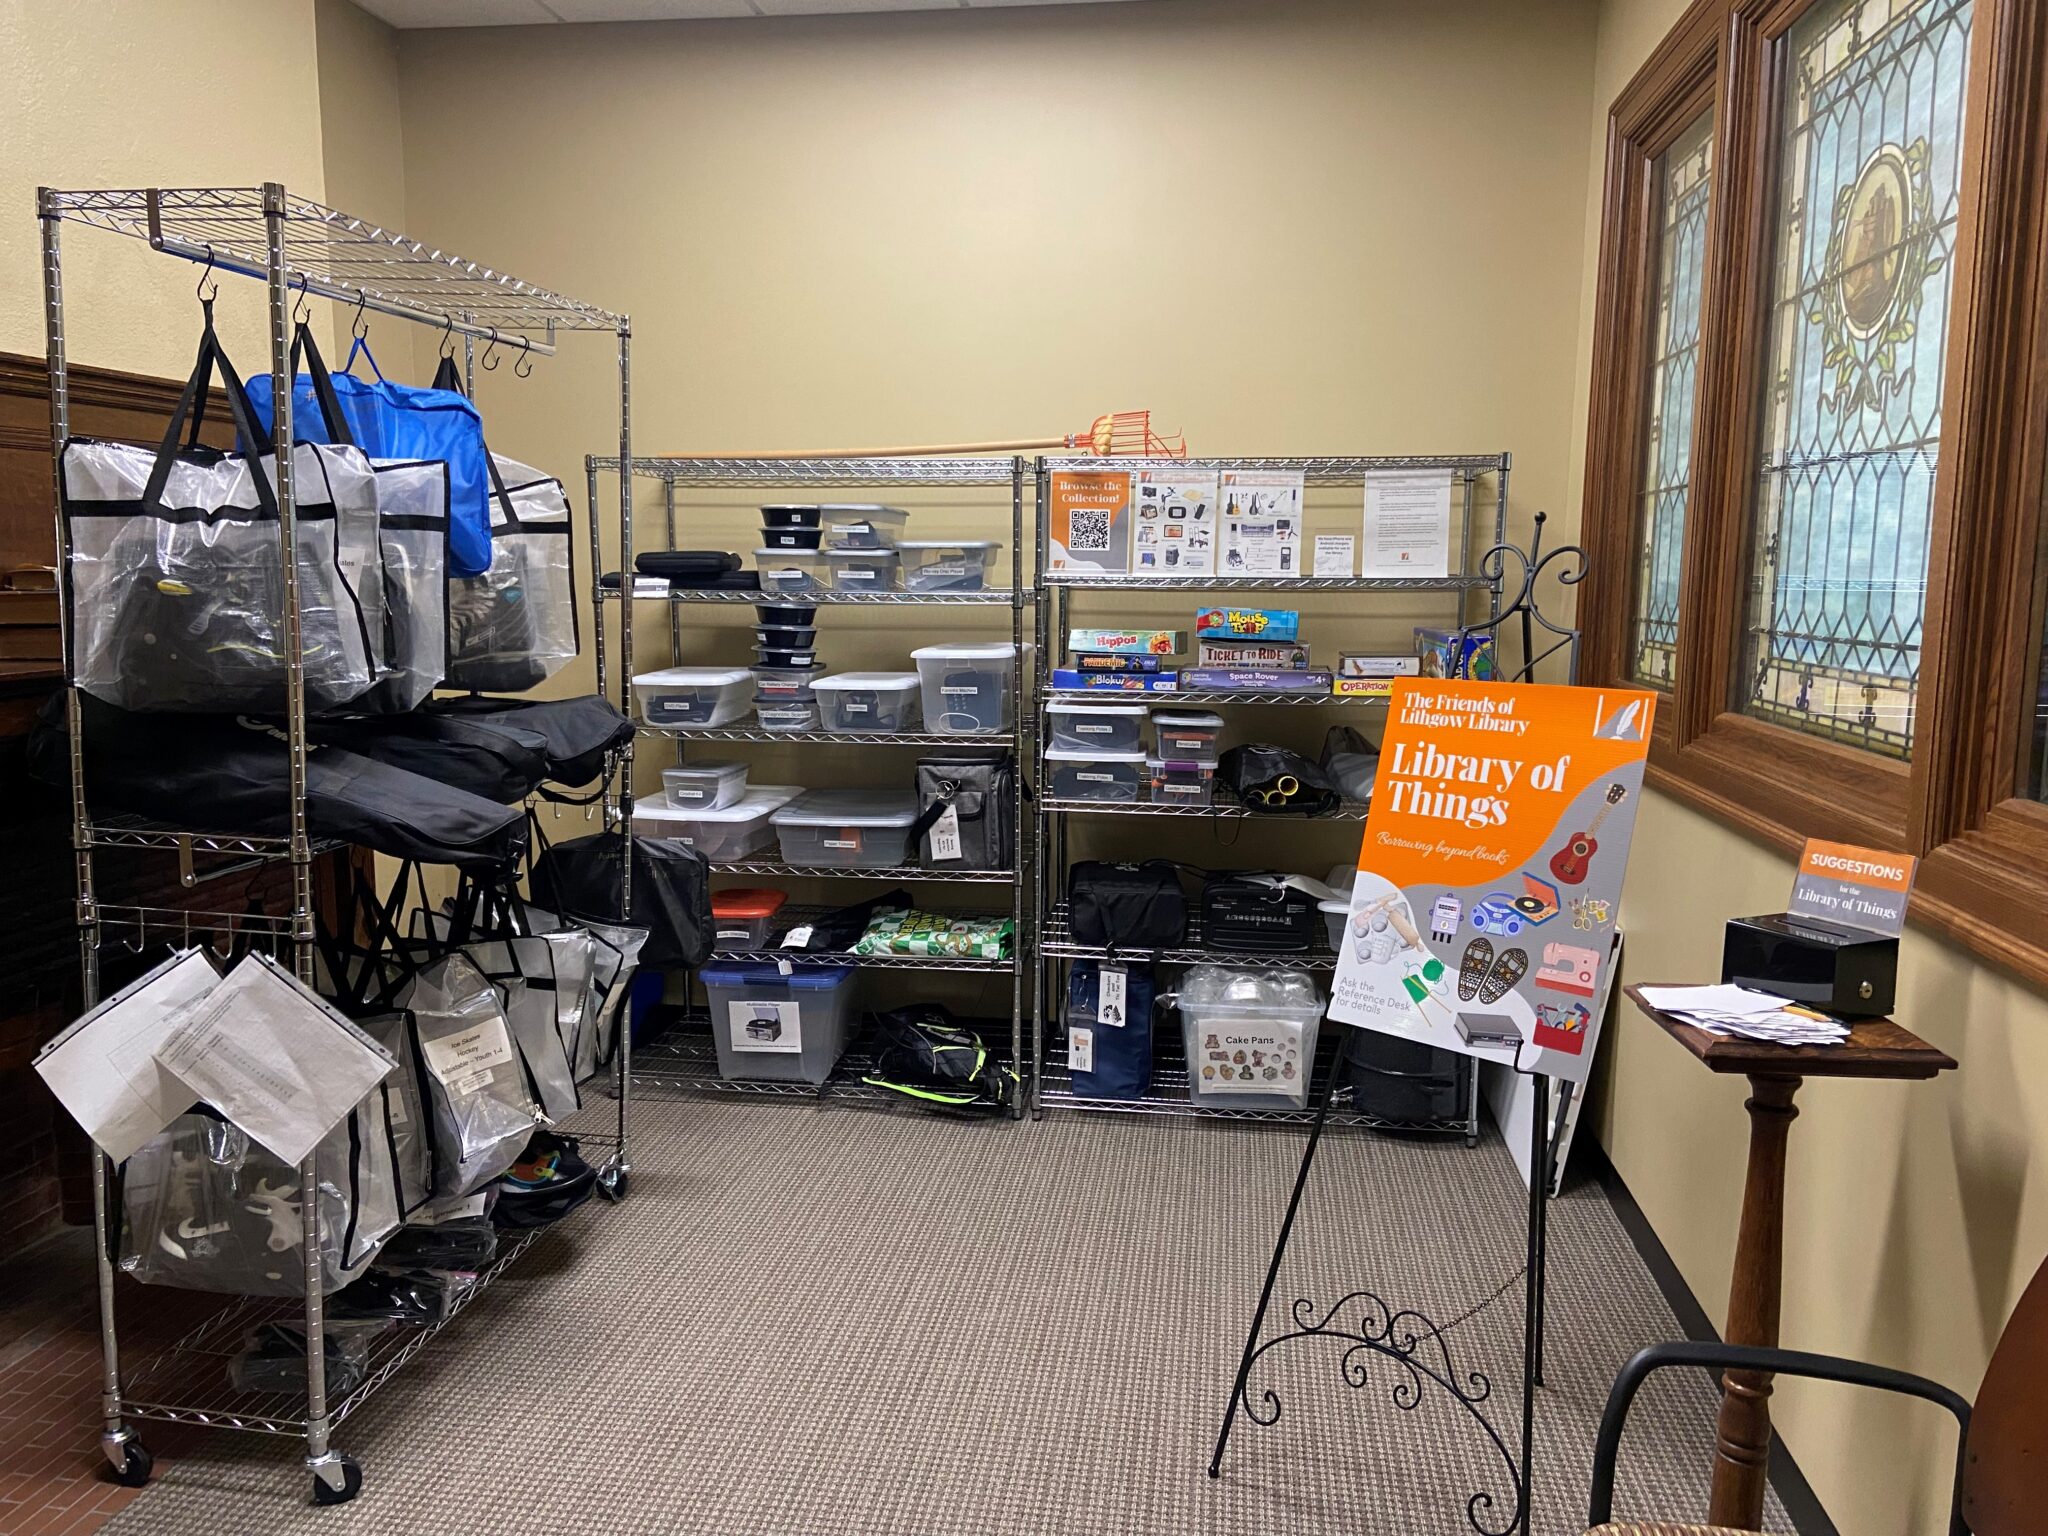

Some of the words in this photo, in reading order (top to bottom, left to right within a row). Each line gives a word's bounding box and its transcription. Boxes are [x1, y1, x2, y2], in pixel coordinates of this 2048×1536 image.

[1059, 481, 1101, 491] Browse
[1103, 481, 1122, 491] the
[1061, 493, 1120, 503] Collection!
[1227, 611, 1268, 625] Mouse
[1231, 622, 1265, 634] Trap
[1096, 635, 1137, 648] Hippos
[1206, 647, 1245, 661] TICKET
[1246, 651, 1256, 659] TO
[1258, 647, 1284, 661] RIDE
[1083, 657, 1126, 667] PANDEMIC
[1096, 675, 1125, 686] Blokus
[1229, 673, 1253, 681] Space
[1255, 673, 1279, 681] Rover
[1340, 682, 1389, 692] OPERATION
[1405, 691, 1434, 708] The
[1436, 693, 1496, 714] Friends
[1498, 697, 1516, 715] of
[1400, 708, 1467, 729] Lithgow
[1468, 713, 1531, 736] Library
[1389, 740, 1524, 793] Library
[1530, 755, 1571, 793] of
[1387, 780, 1510, 829] Things
[1376, 831, 1434, 858] Borrowing
[1435, 840, 1480, 861] beyond
[1476, 845, 1510, 866] books
[1810, 853, 1904, 881] SUGGESTIONS
[1839, 885, 1849, 893] for
[1849, 887, 1861, 895] the
[1798, 888, 1840, 909] Library
[1841, 898, 1855, 910] of
[1856, 900, 1898, 919] Things
[1340, 976, 1358, 988] Ask
[1360, 981, 1375, 992] the
[1336, 996, 1350, 1007] for
[1351, 1000, 1381, 1015] details
[1337, 986, 1385, 1005] Reference
[1387, 998, 1411, 1011] Desk
[461, 1034, 481, 1045] Skates
[1225, 1036, 1249, 1045] Cake
[1251, 1036, 1274, 1044] Pans
[457, 1046, 479, 1058] Hockey
[441, 1060, 469, 1075] Adjustable
[474, 1052, 492, 1062] Youth
